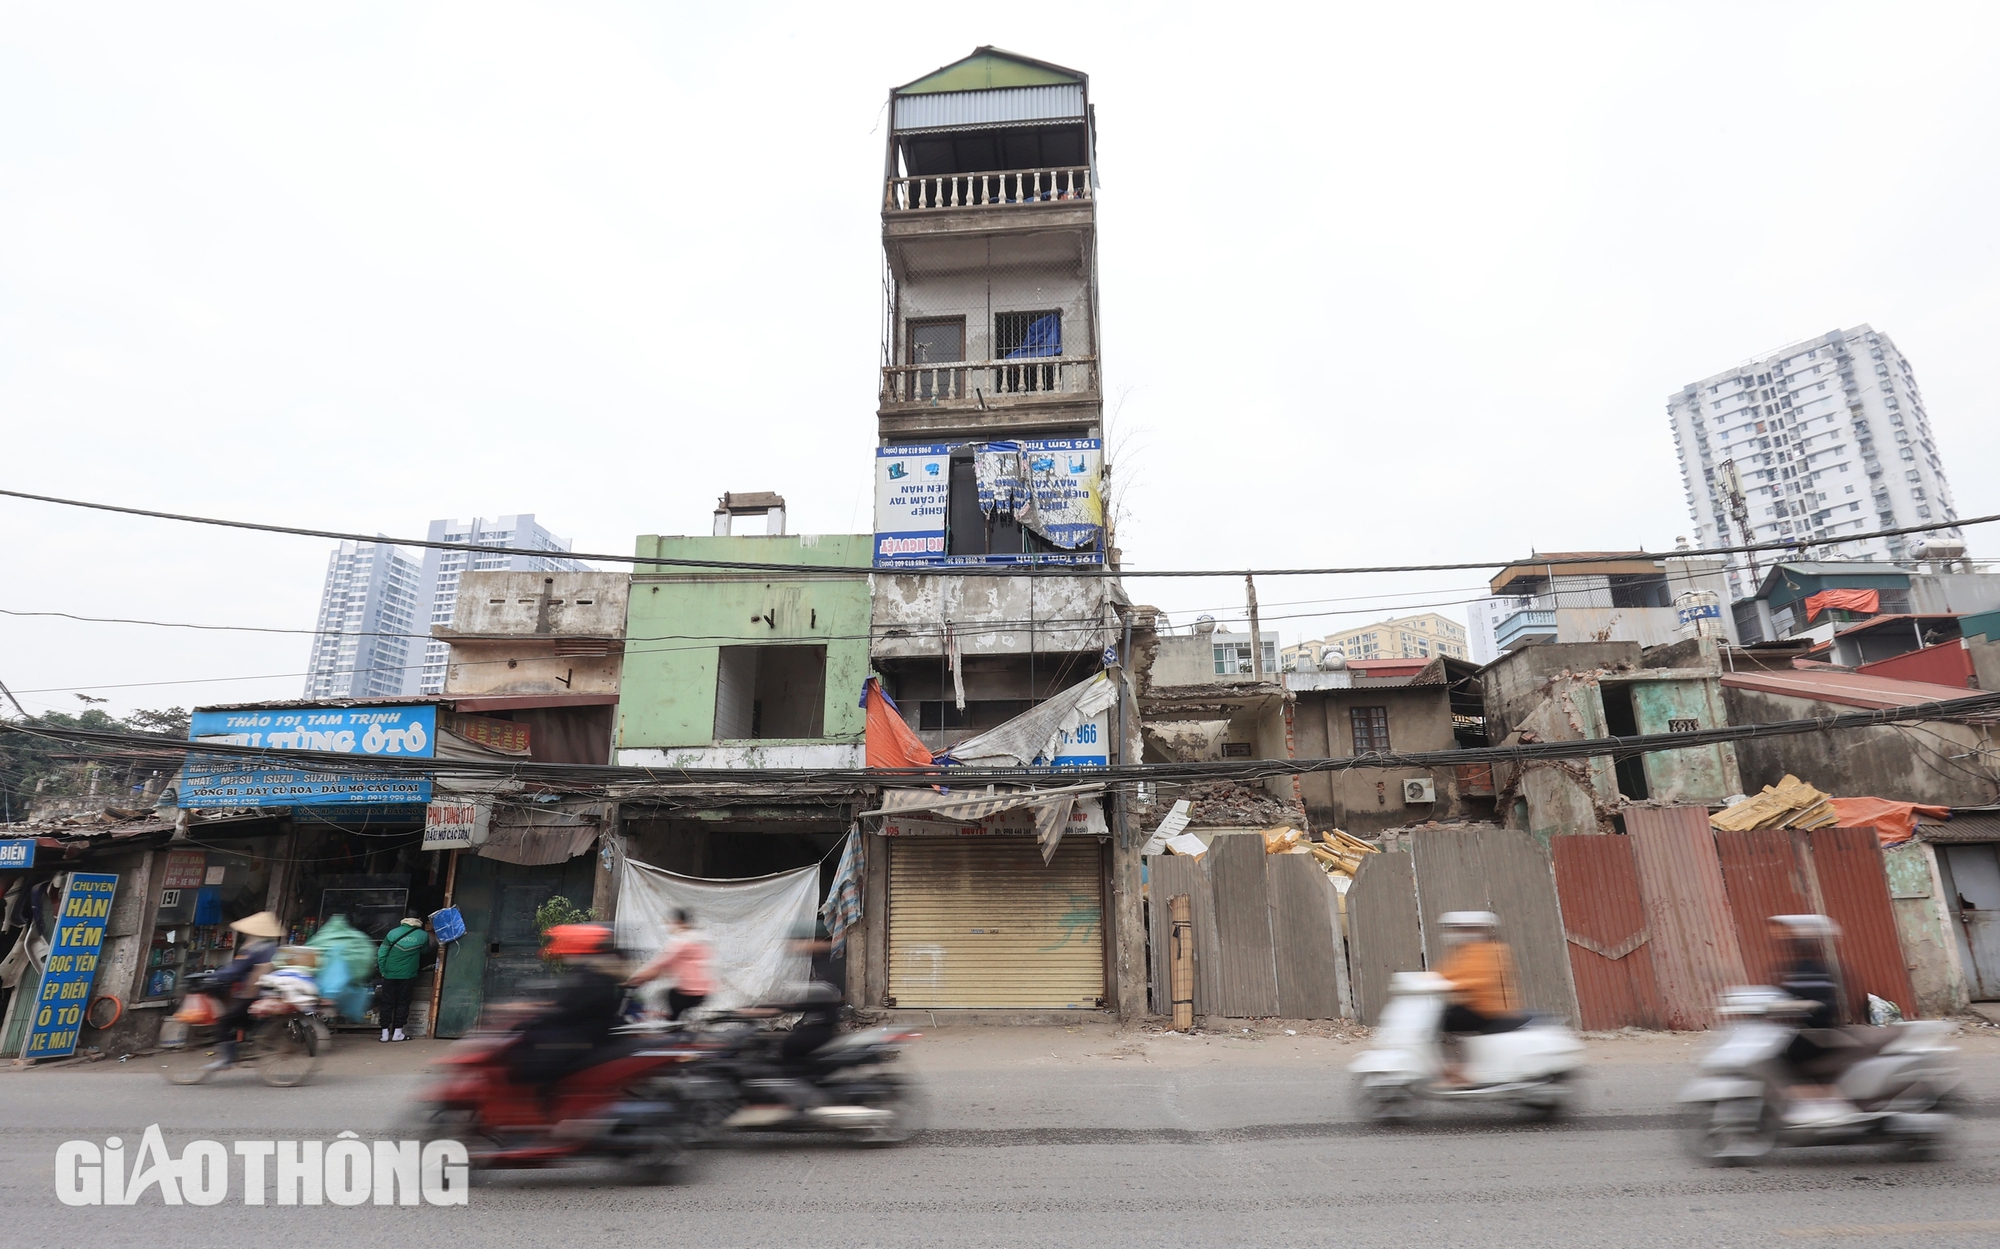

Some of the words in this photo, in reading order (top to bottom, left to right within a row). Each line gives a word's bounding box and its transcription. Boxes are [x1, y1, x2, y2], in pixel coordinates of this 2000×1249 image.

[1048, 441, 1072, 449] Tam
[1075, 440, 1095, 449] 195
[888, 497, 907, 506] TAY
[879, 536, 927, 557] NGUYỆT
[1048, 554, 1072, 564] Tam
[1075, 554, 1097, 563] 195
[226, 712, 270, 730] THẢO
[275, 716, 301, 730] 191
[308, 714, 342, 727] TAM
[362, 721, 427, 753] ÔTÔ
[502, 724, 515, 750] CHỮ
[1077, 723, 1097, 744] 966
[221, 775, 254, 786] MITSU
[263, 774, 293, 785] ISUZU
[303, 773, 341, 783] SUZUKI
[226, 788, 238, 797] BI
[246, 785, 270, 796] DÂY
[290, 785, 313, 795] ROA
[367, 782, 391, 793] CÁC
[391, 783, 420, 795] LOẠI
[427, 806, 442, 828] PHỤ
[885, 826, 900, 836] 195
[180, 878, 188, 886] XE
[65, 894, 110, 918] HÀN
[162, 891, 179, 905] 191
[60, 920, 103, 947] YẾM
[48, 955, 73, 977] BỌC
[74, 952, 98, 972] YÊN
[42, 979, 59, 1001] ÉP
[37, 1005, 52, 1027] Ô
[57, 1003, 80, 1026] TÔ
[29, 1032, 48, 1051] XE
[47, 1027, 76, 1050] MÁY
